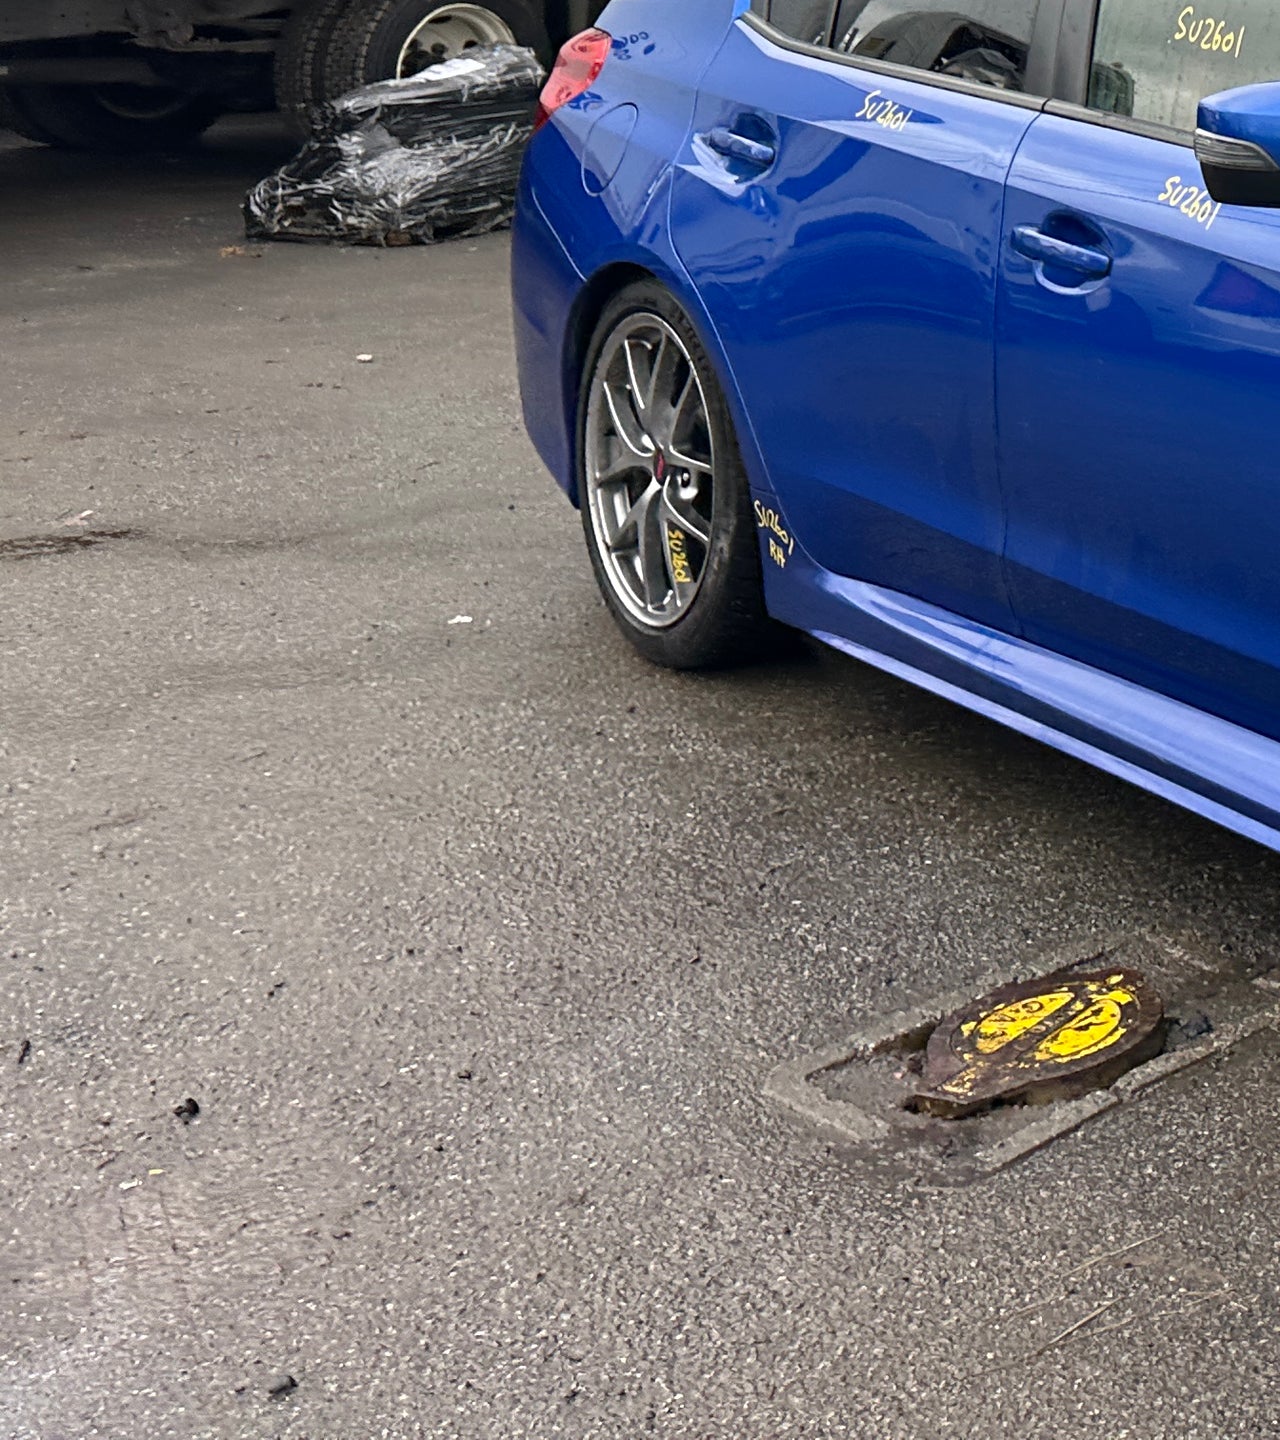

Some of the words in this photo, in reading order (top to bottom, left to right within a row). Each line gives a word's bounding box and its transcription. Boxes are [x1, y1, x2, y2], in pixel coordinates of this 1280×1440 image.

[1174, 6, 1245, 58] SU2601
[855, 89, 914, 132] SU2601
[1158, 176, 1222, 231] SU2601
[753, 500, 794, 556] SU2601
